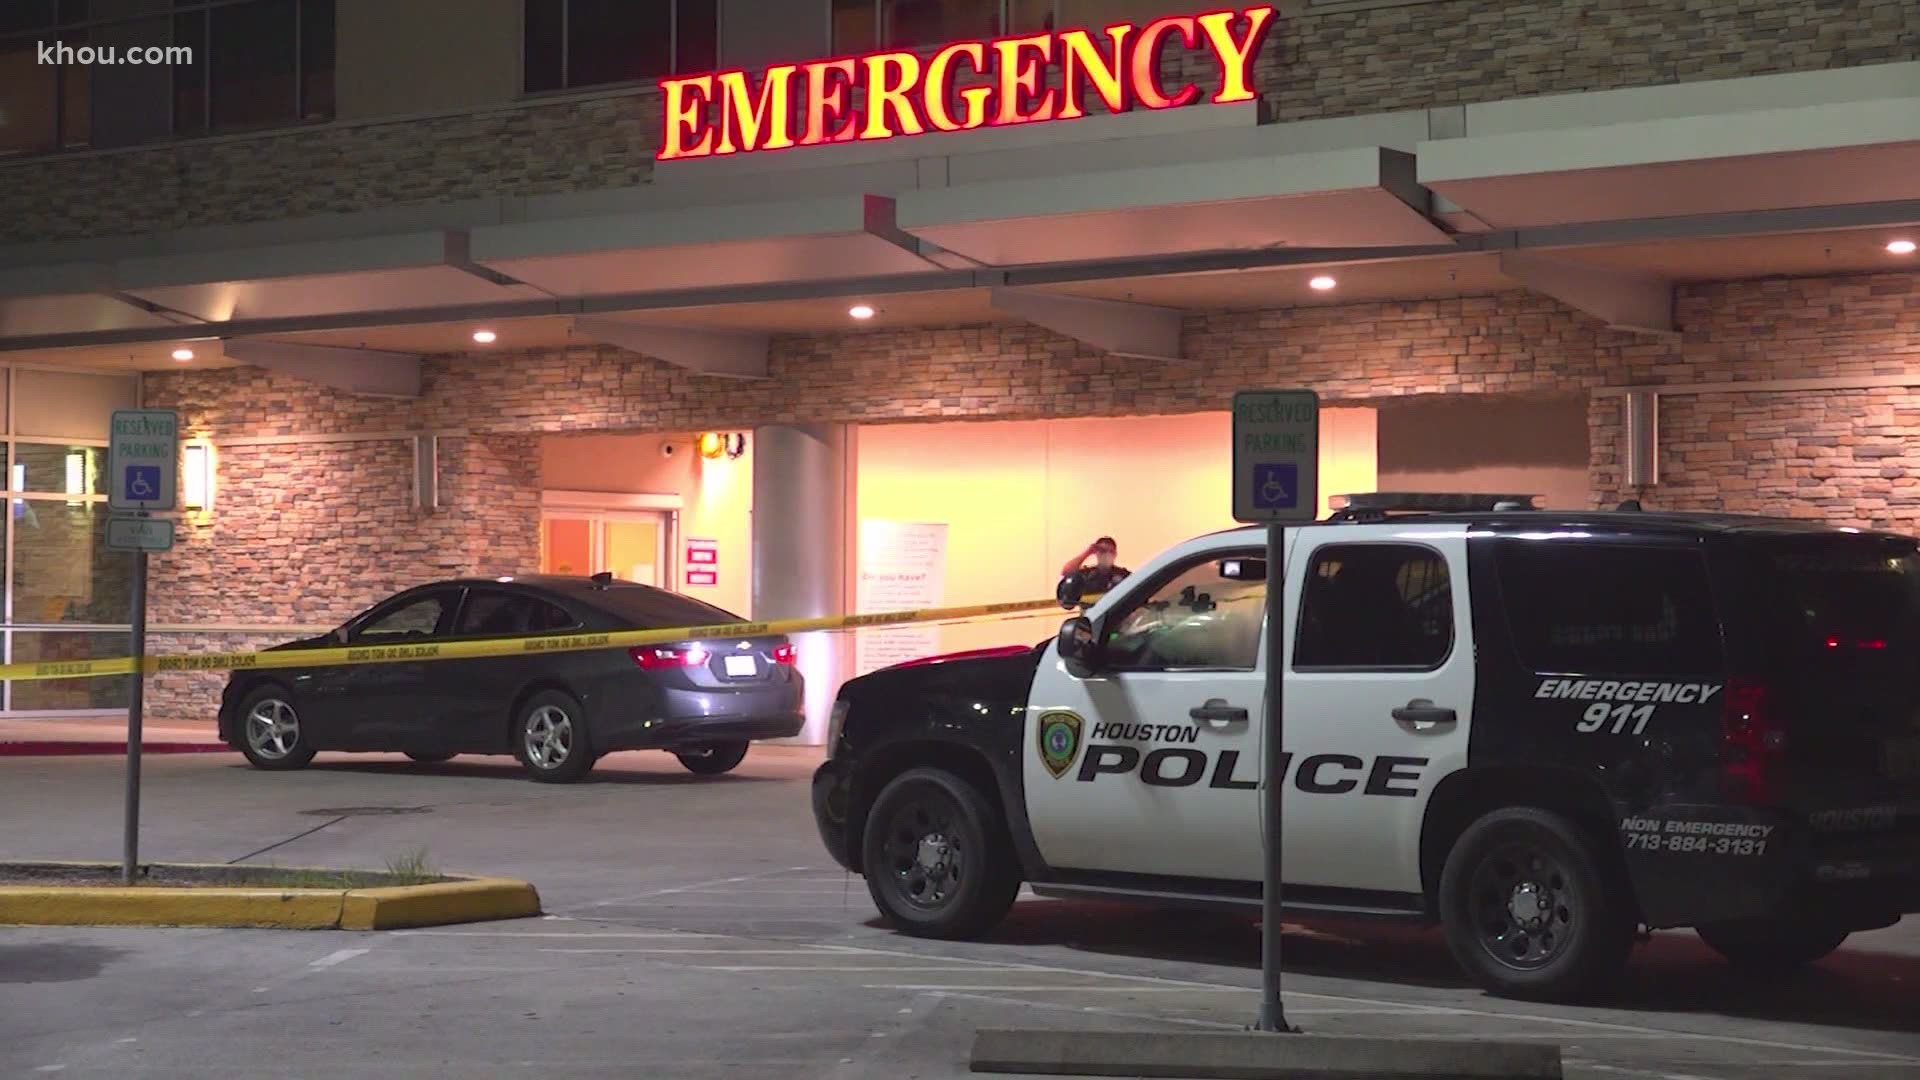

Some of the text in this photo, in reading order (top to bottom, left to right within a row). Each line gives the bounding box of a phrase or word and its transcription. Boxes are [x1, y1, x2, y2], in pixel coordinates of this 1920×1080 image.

[656, 4, 1277, 161] EMERGENCY
[115, 420, 173, 436] RESERVED
[120, 443, 169, 457] PARKING
[1534, 679, 1723, 704] EMERGENCY
[1576, 702, 1656, 735] 911
[1091, 722, 1200, 743] HOUSTON
[1076, 745, 1430, 798] POLCE
[1621, 816, 1775, 837] NON EMERGENCY
[1627, 833, 1767, 856] 713-884-3131
